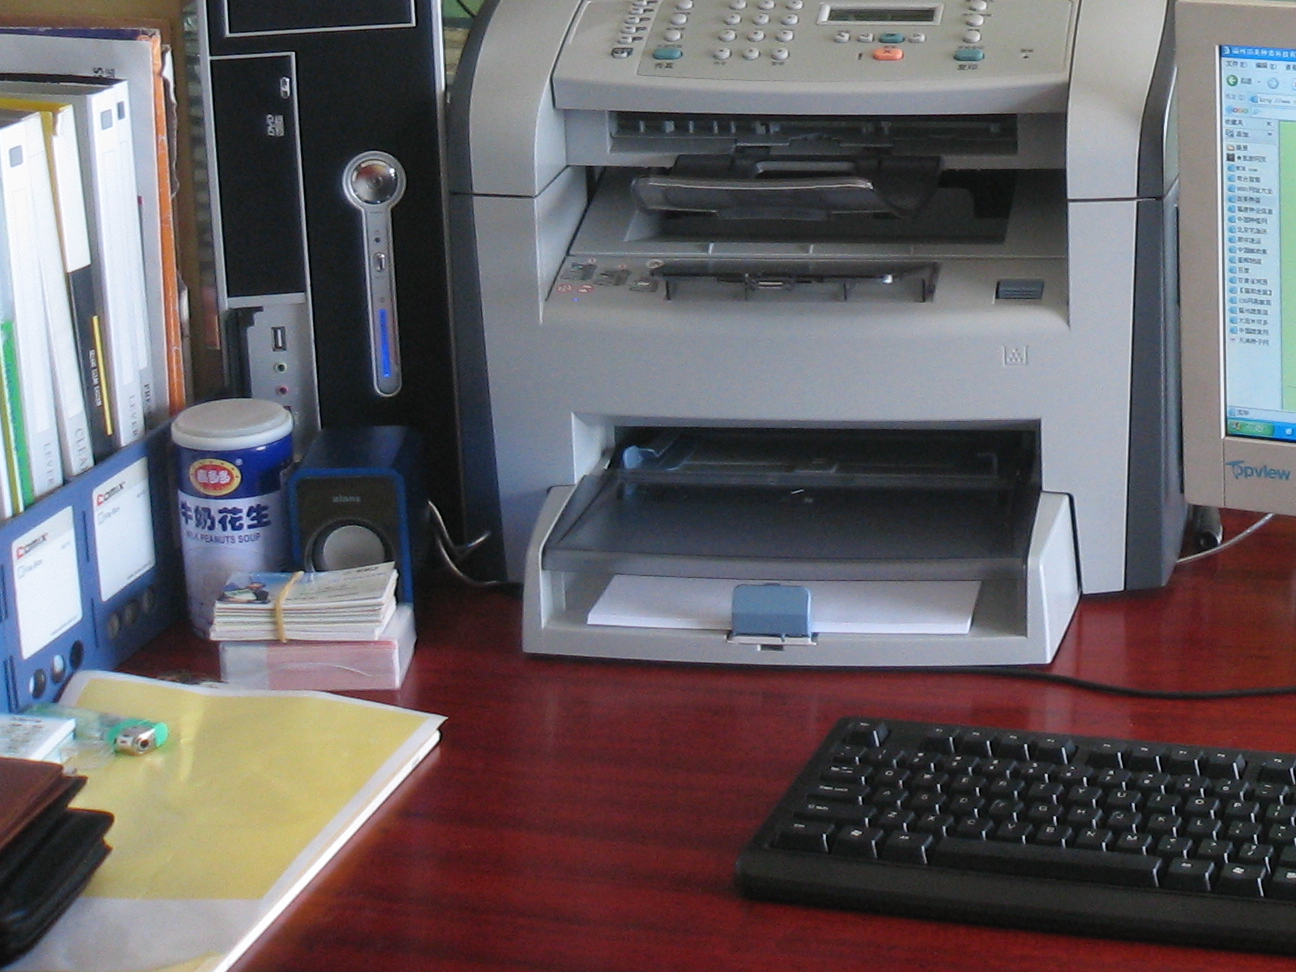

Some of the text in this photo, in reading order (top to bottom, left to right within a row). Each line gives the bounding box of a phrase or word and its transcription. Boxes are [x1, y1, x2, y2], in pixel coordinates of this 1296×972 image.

[180, 500, 272, 532] 牛奶花生
[200, 532, 261, 545] PEANUTS SOUP
